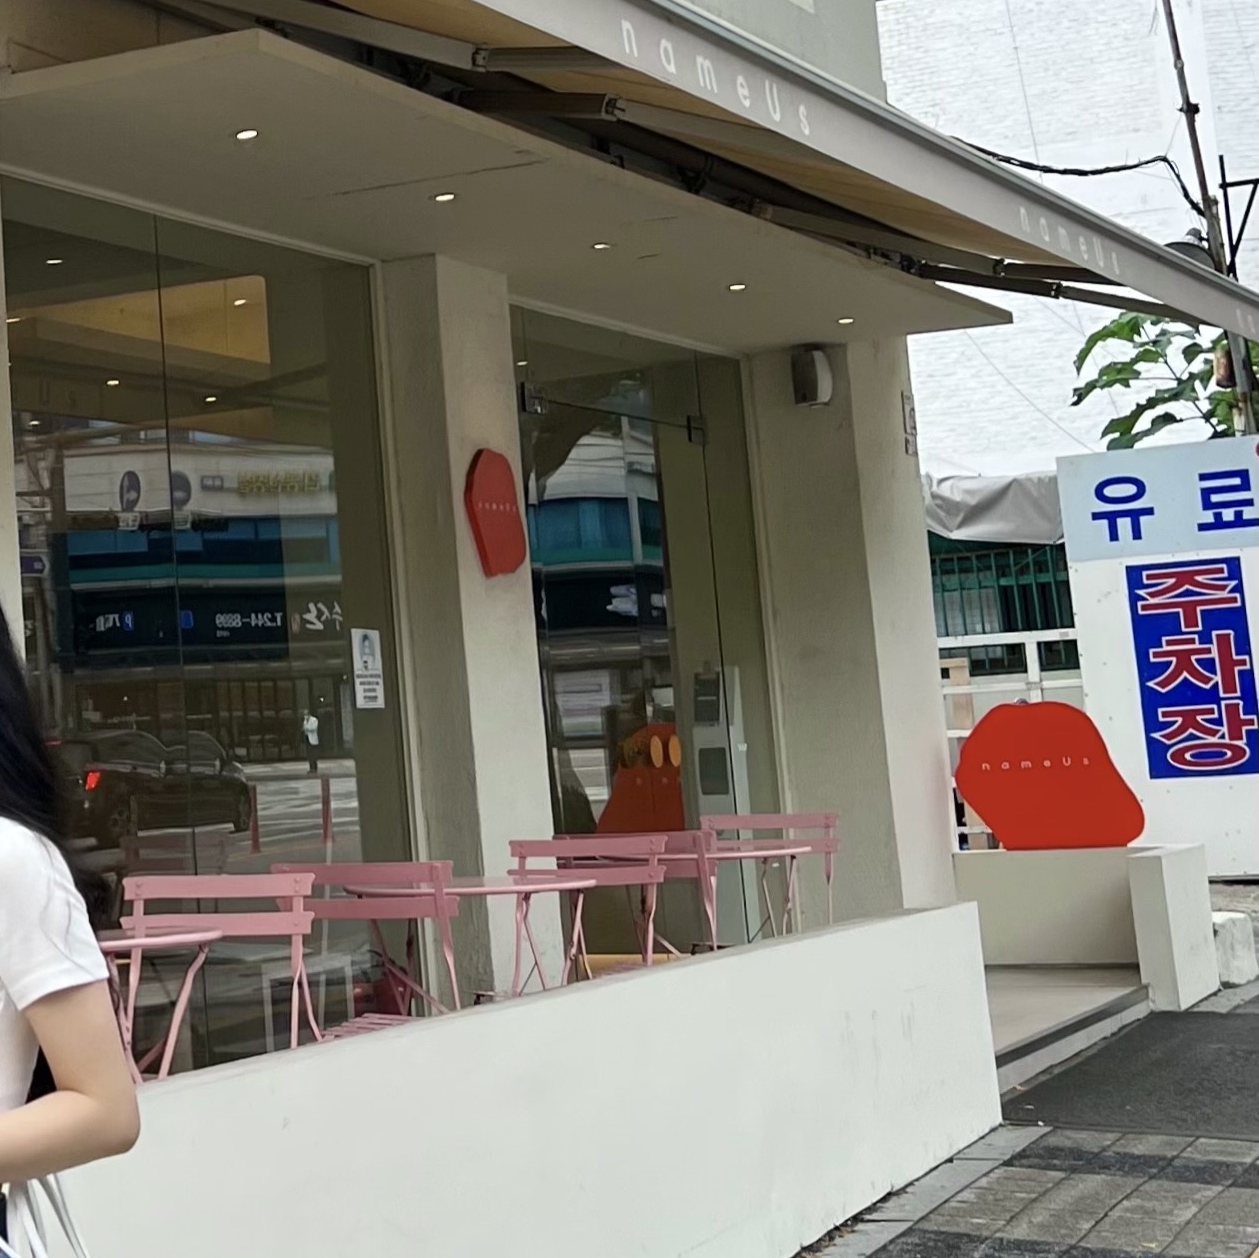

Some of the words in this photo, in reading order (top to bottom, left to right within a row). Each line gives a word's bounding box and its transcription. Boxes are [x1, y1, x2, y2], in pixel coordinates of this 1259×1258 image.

[621, 18, 811, 137] nameUs
[1018, 206, 1121, 276] nameUs
[1090, 468, 1259, 542] 유료
[1134, 563, 1258, 771] 주차장
[981, 756, 1090, 771] nameUs
